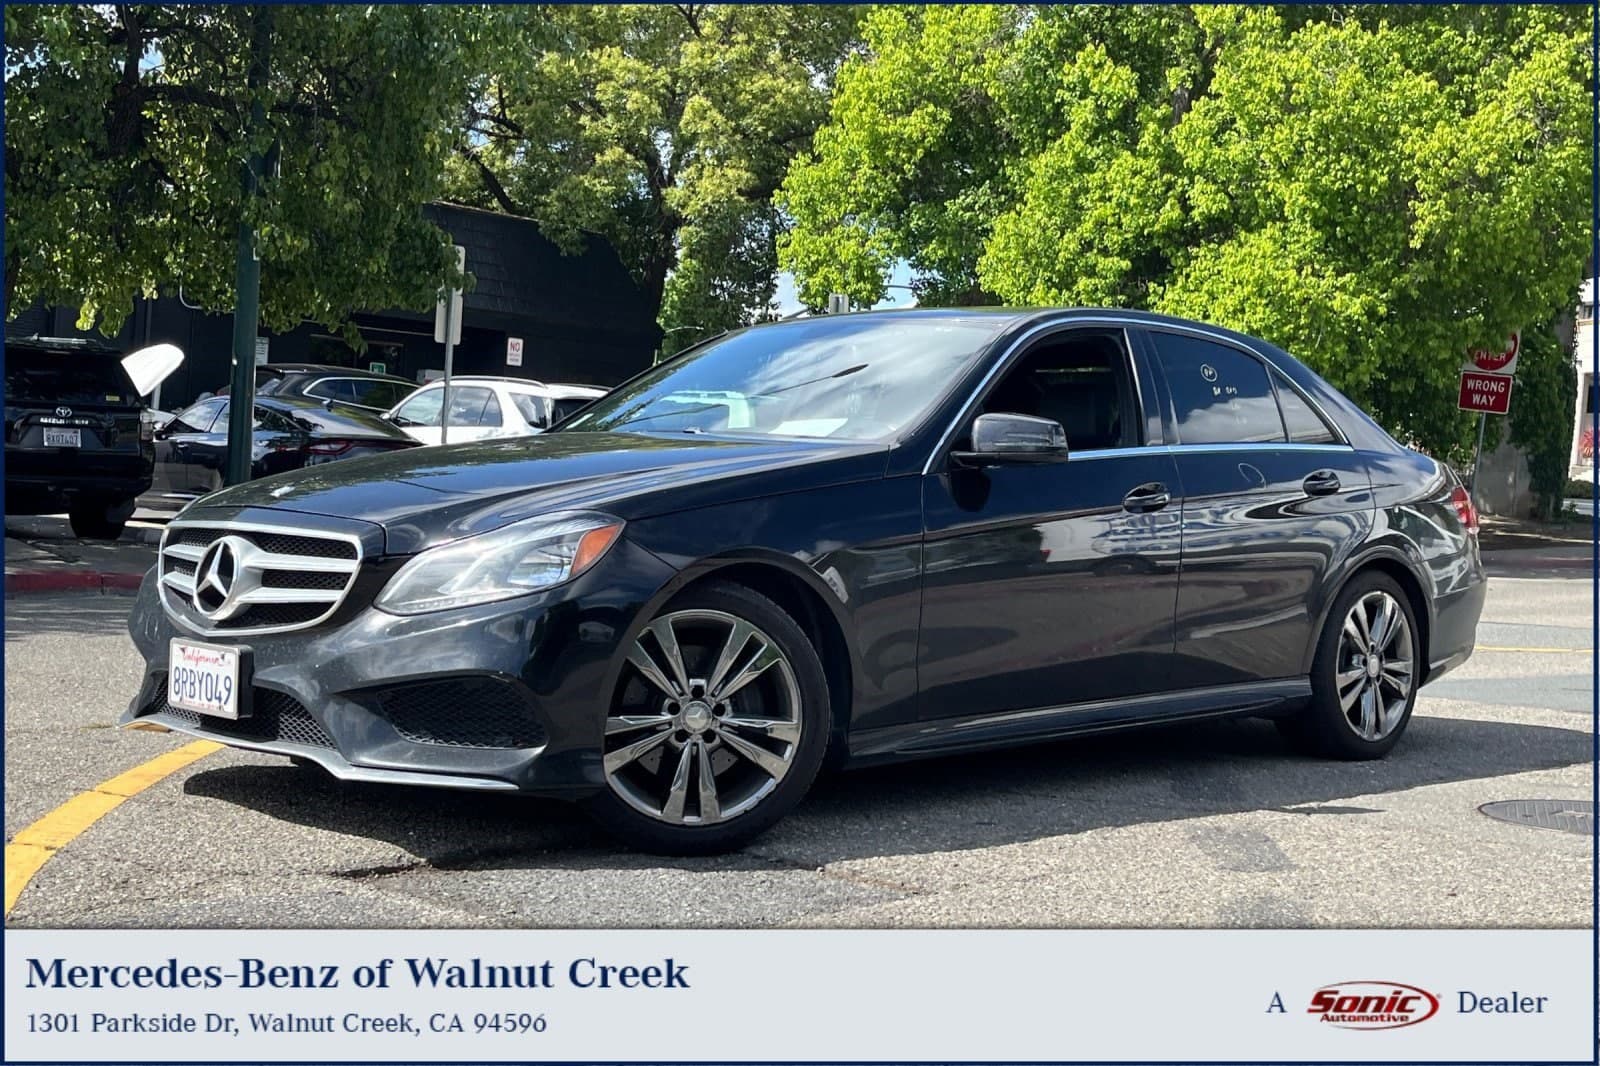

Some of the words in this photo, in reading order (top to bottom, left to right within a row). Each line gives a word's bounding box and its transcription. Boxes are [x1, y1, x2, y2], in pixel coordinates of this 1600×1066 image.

[510, 341, 520, 352] NO
[1467, 379, 1505, 393] WRONG
[1472, 393, 1496, 406] WAY
[182, 644, 222, 667] California
[173, 666, 232, 705] 8RBY049
